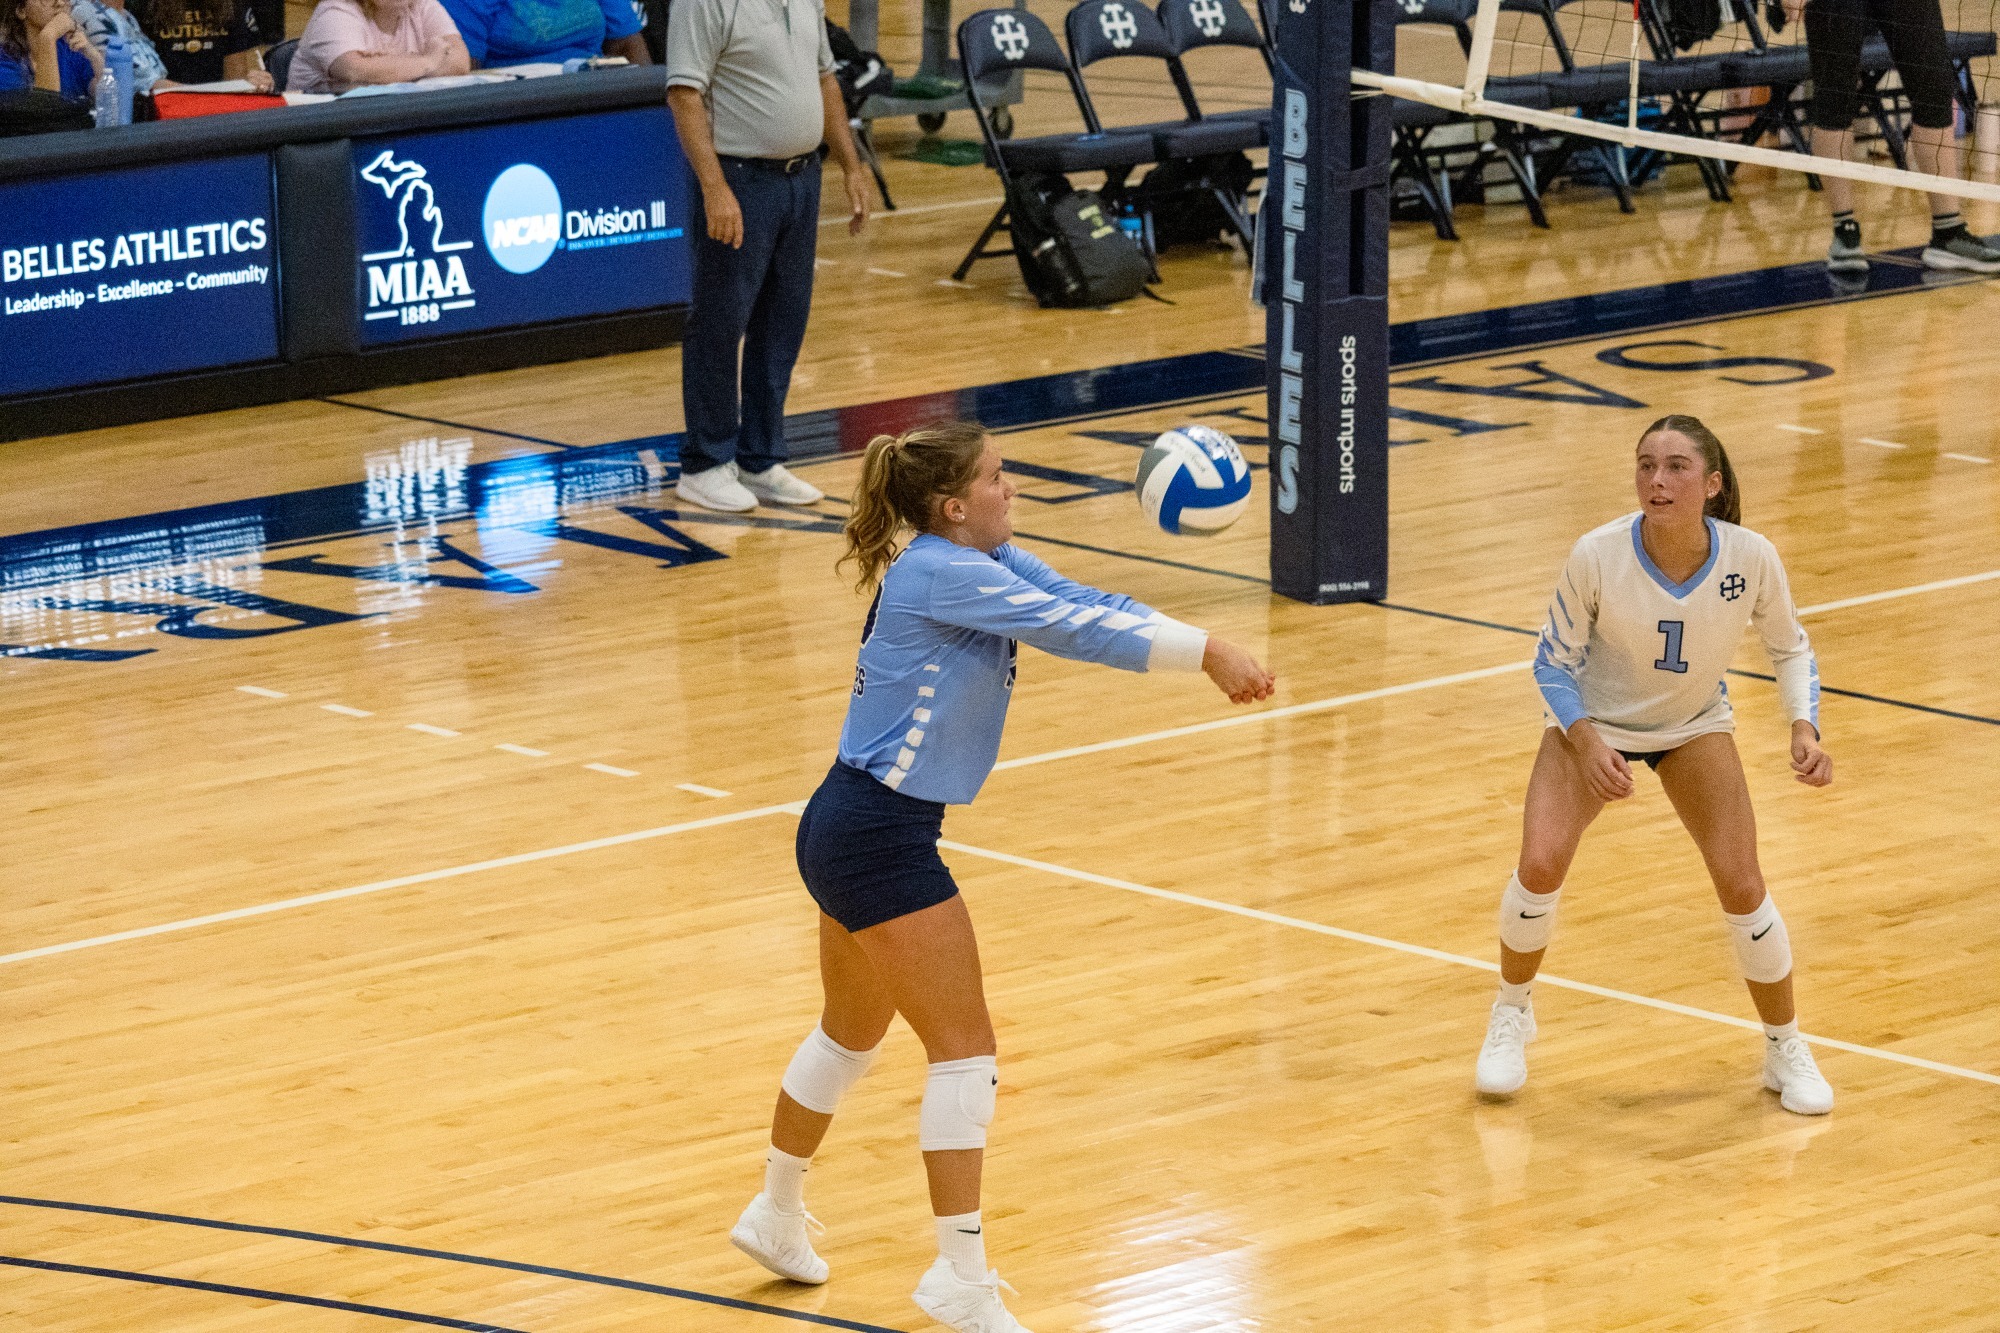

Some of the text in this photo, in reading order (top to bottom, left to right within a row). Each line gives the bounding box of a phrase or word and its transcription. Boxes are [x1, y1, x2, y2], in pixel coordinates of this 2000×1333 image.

[492, 213, 561, 249] NCAA
[566, 200, 667, 239] Division III
[3, 217, 267, 282] BELLES ATHLETICS
[5, 287, 85, 315] Leadership
[97, 279, 174, 303] Excellence
[186, 264, 269, 291] Community
[367, 255, 473, 307] MIAA
[1277, 88, 1308, 515] BELLES
[401, 302, 440, 326] 1888
[1338, 335, 1357, 495] sports imports
[1654, 620, 1689, 674] 1
